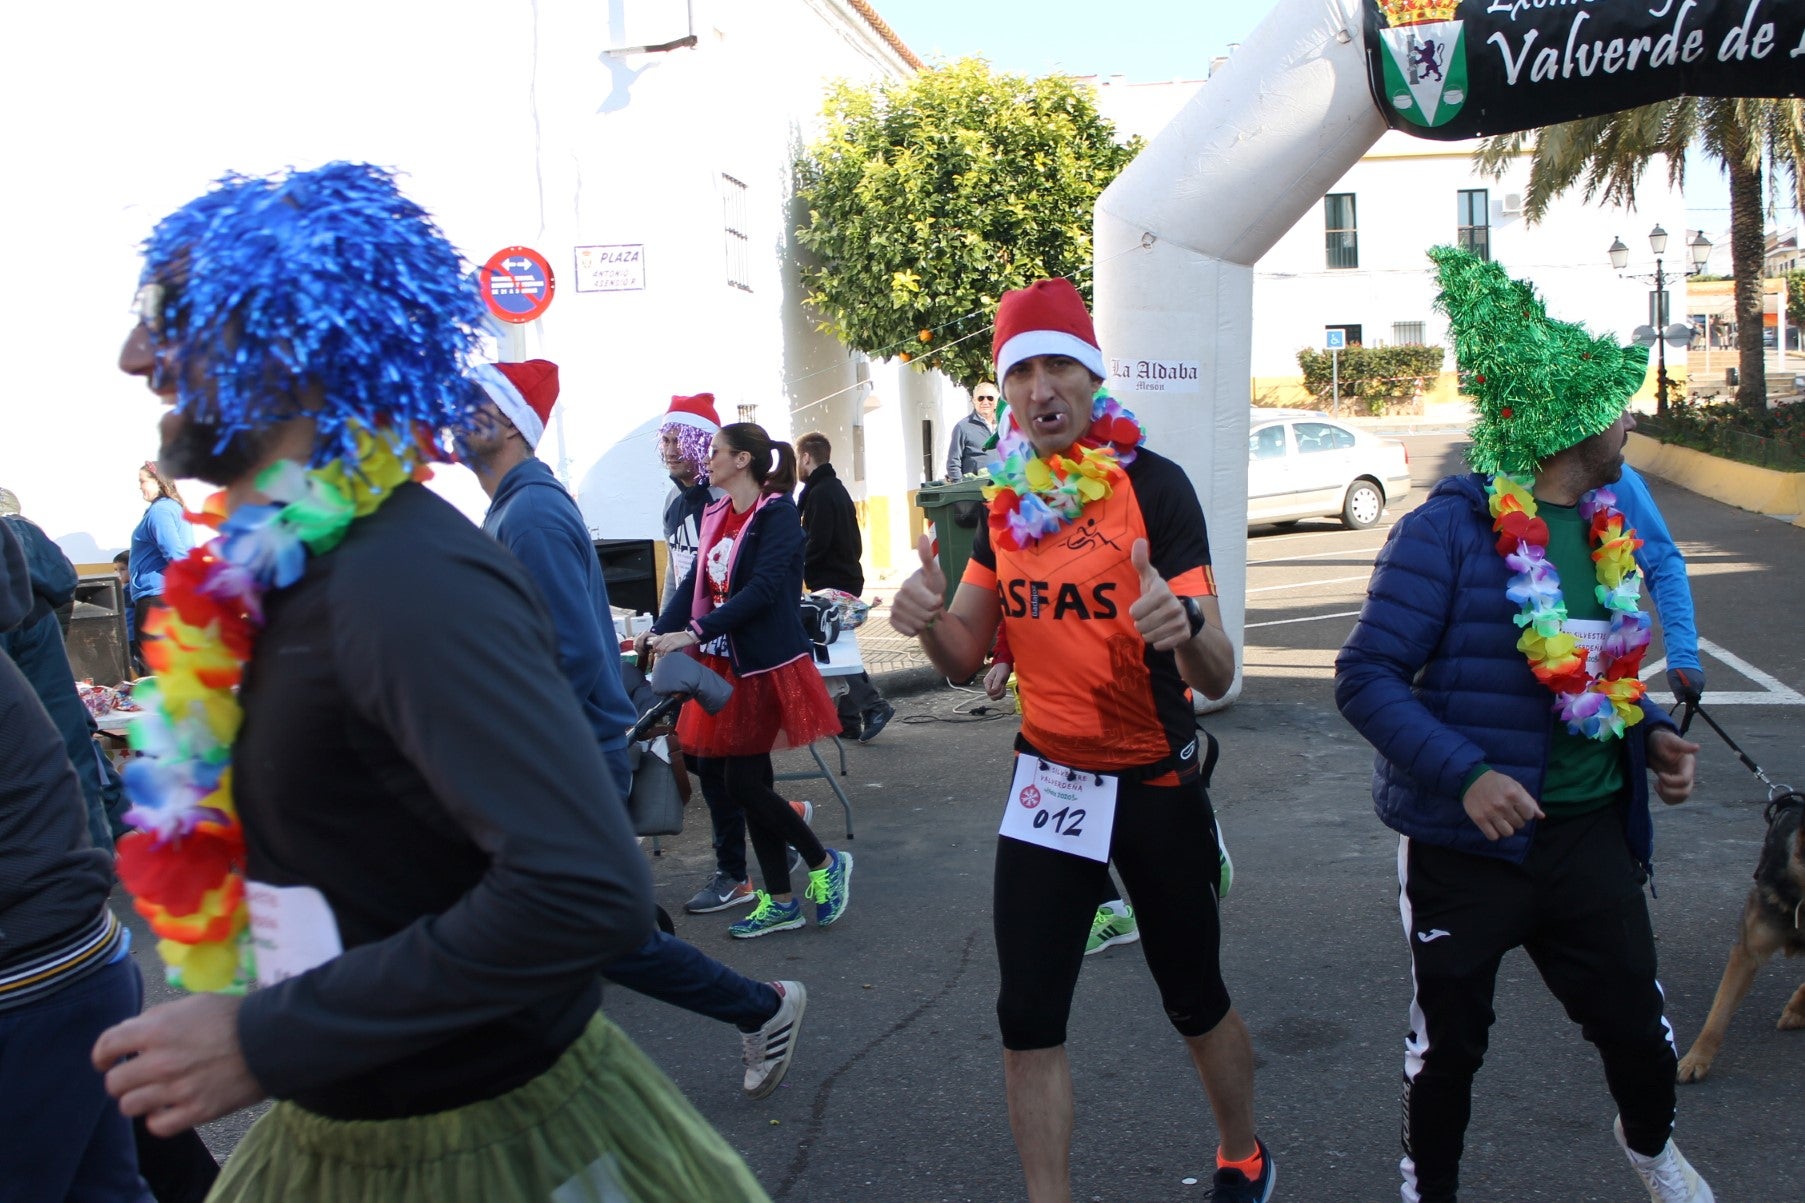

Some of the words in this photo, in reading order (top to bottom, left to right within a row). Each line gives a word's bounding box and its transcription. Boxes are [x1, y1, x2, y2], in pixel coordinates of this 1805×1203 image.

[1486, 0, 1703, 85] Valverde
[1716, 0, 1775, 61] de
[600, 251, 639, 263] PLAZA
[1112, 359, 1131, 378] La
[1136, 360, 1198, 379] Aldaba
[996, 579, 1117, 620] ASFAS
[1033, 806, 1086, 836] 012
